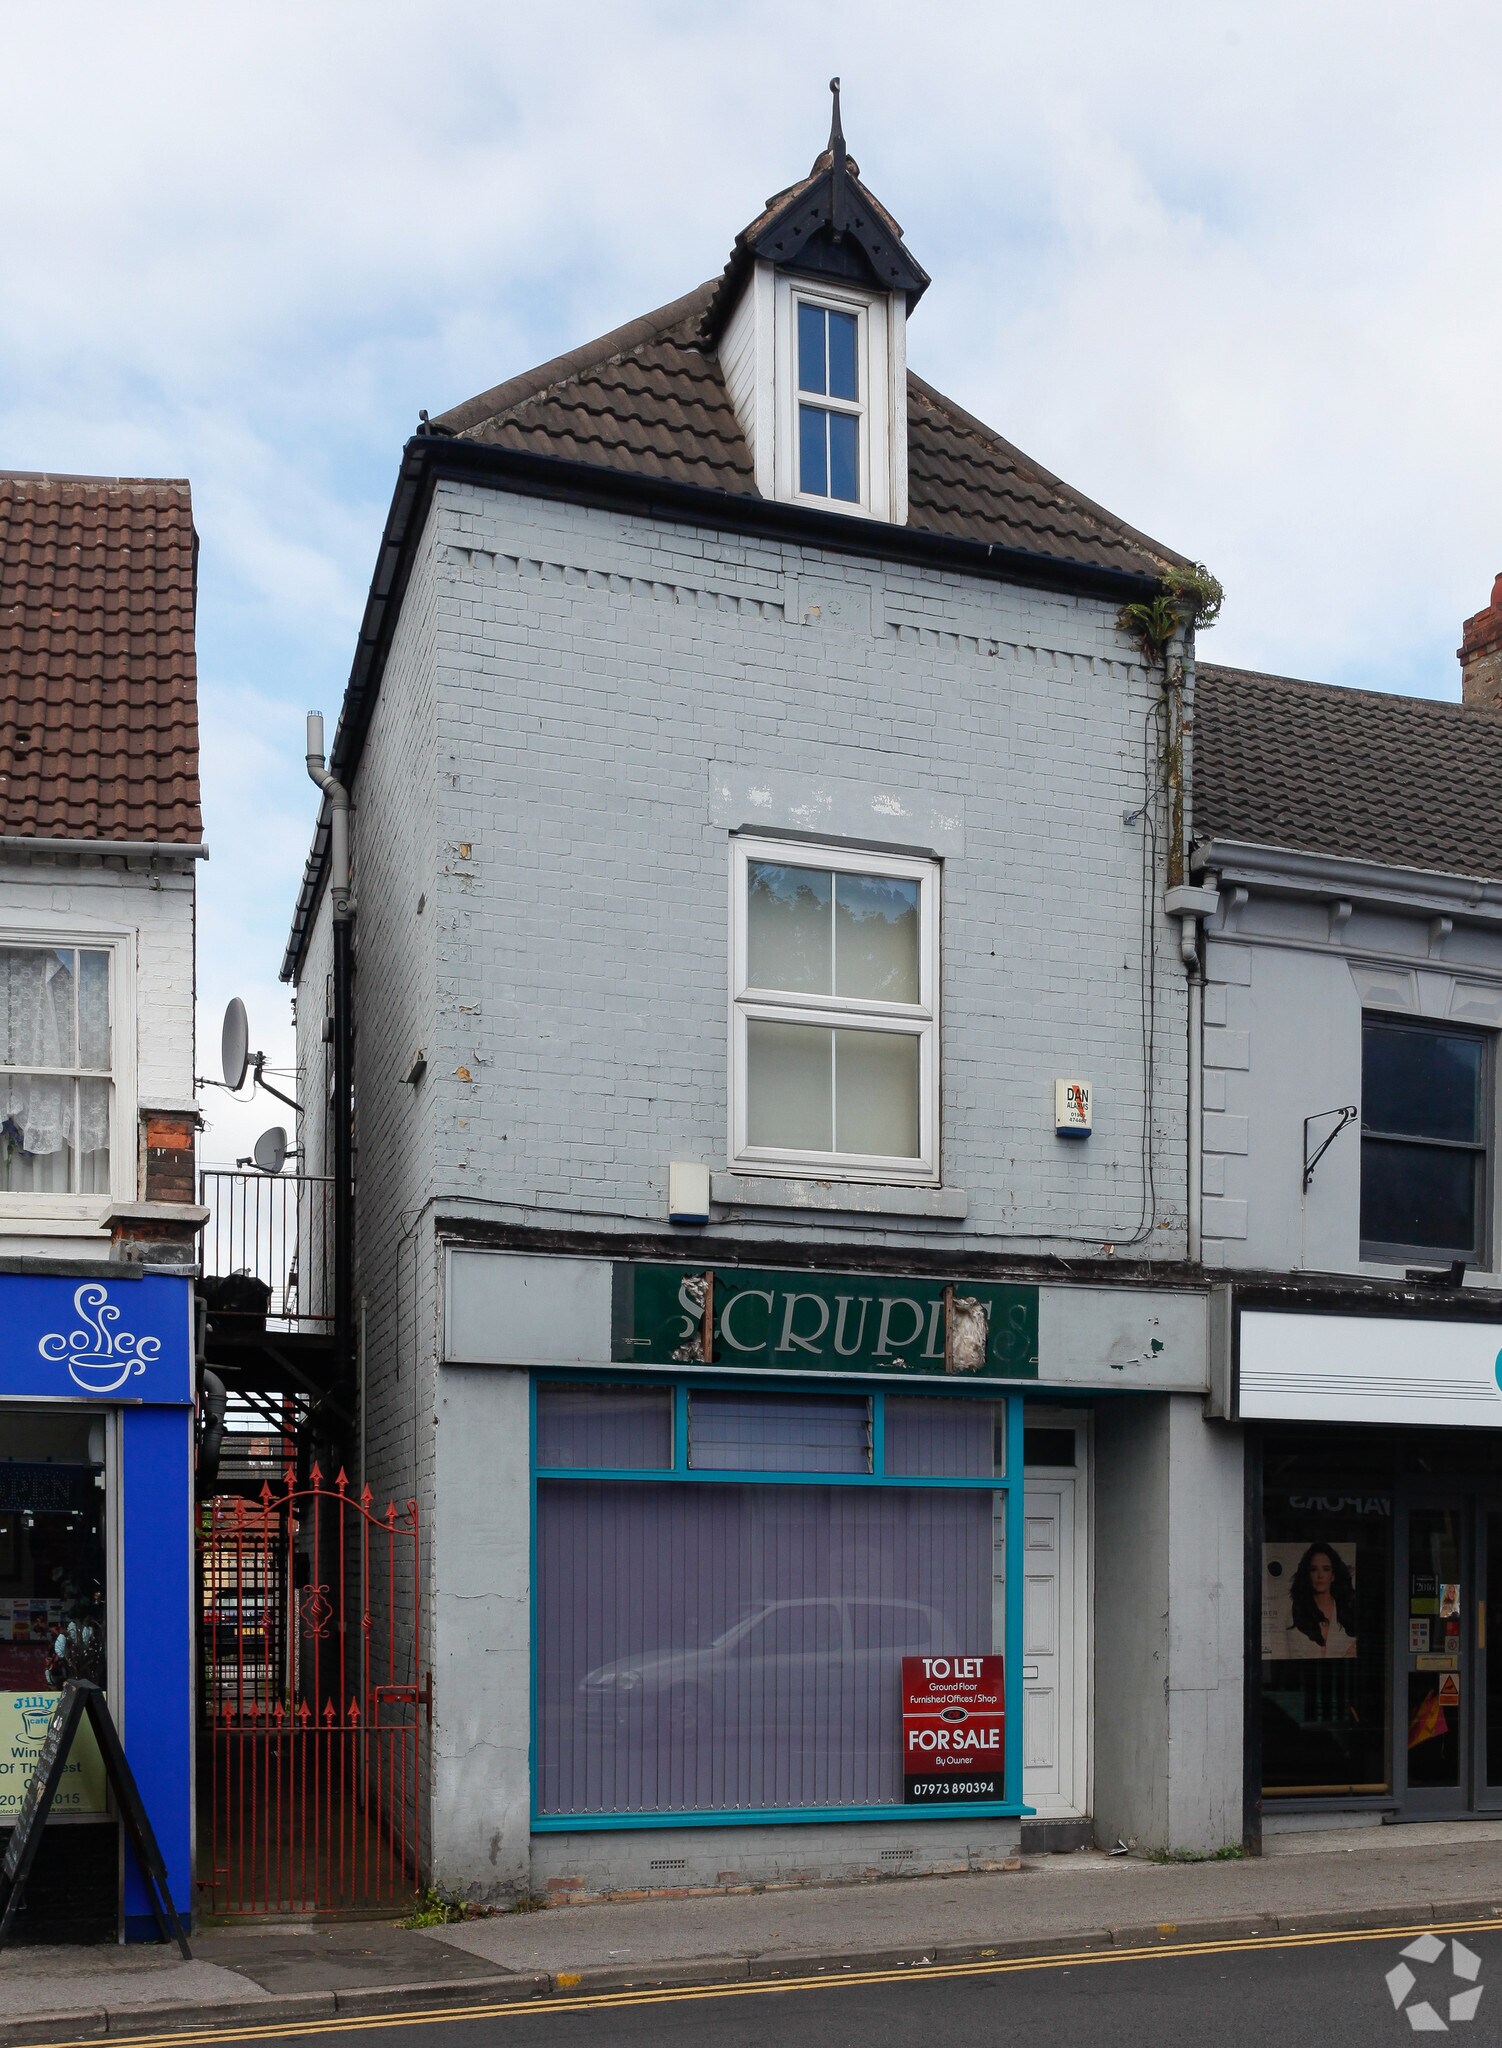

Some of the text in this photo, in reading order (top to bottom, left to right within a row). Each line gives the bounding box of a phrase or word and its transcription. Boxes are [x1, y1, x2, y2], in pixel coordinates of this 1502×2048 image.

[1067, 1087, 1089, 1103] DAN
[38, 1283, 161, 1361] coffee
[922, 1658, 984, 1679] TO LET
[929, 1682, 978, 1691] Ground Floor
[13, 1696, 62, 1710] Jilly'
[910, 1694, 946, 1704] Furnished
[946, 1694, 973, 1703] Offices
[977, 1693, 997, 1704] Shop
[909, 1729, 1000, 1751] FOR SALE
[935, 1756, 973, 1766] By Owner
[0, 1762, 82, 1774] Of Th est
[914, 1782, 994, 1795] 07973 890394
[0, 1793, 81, 1805] 201 015
